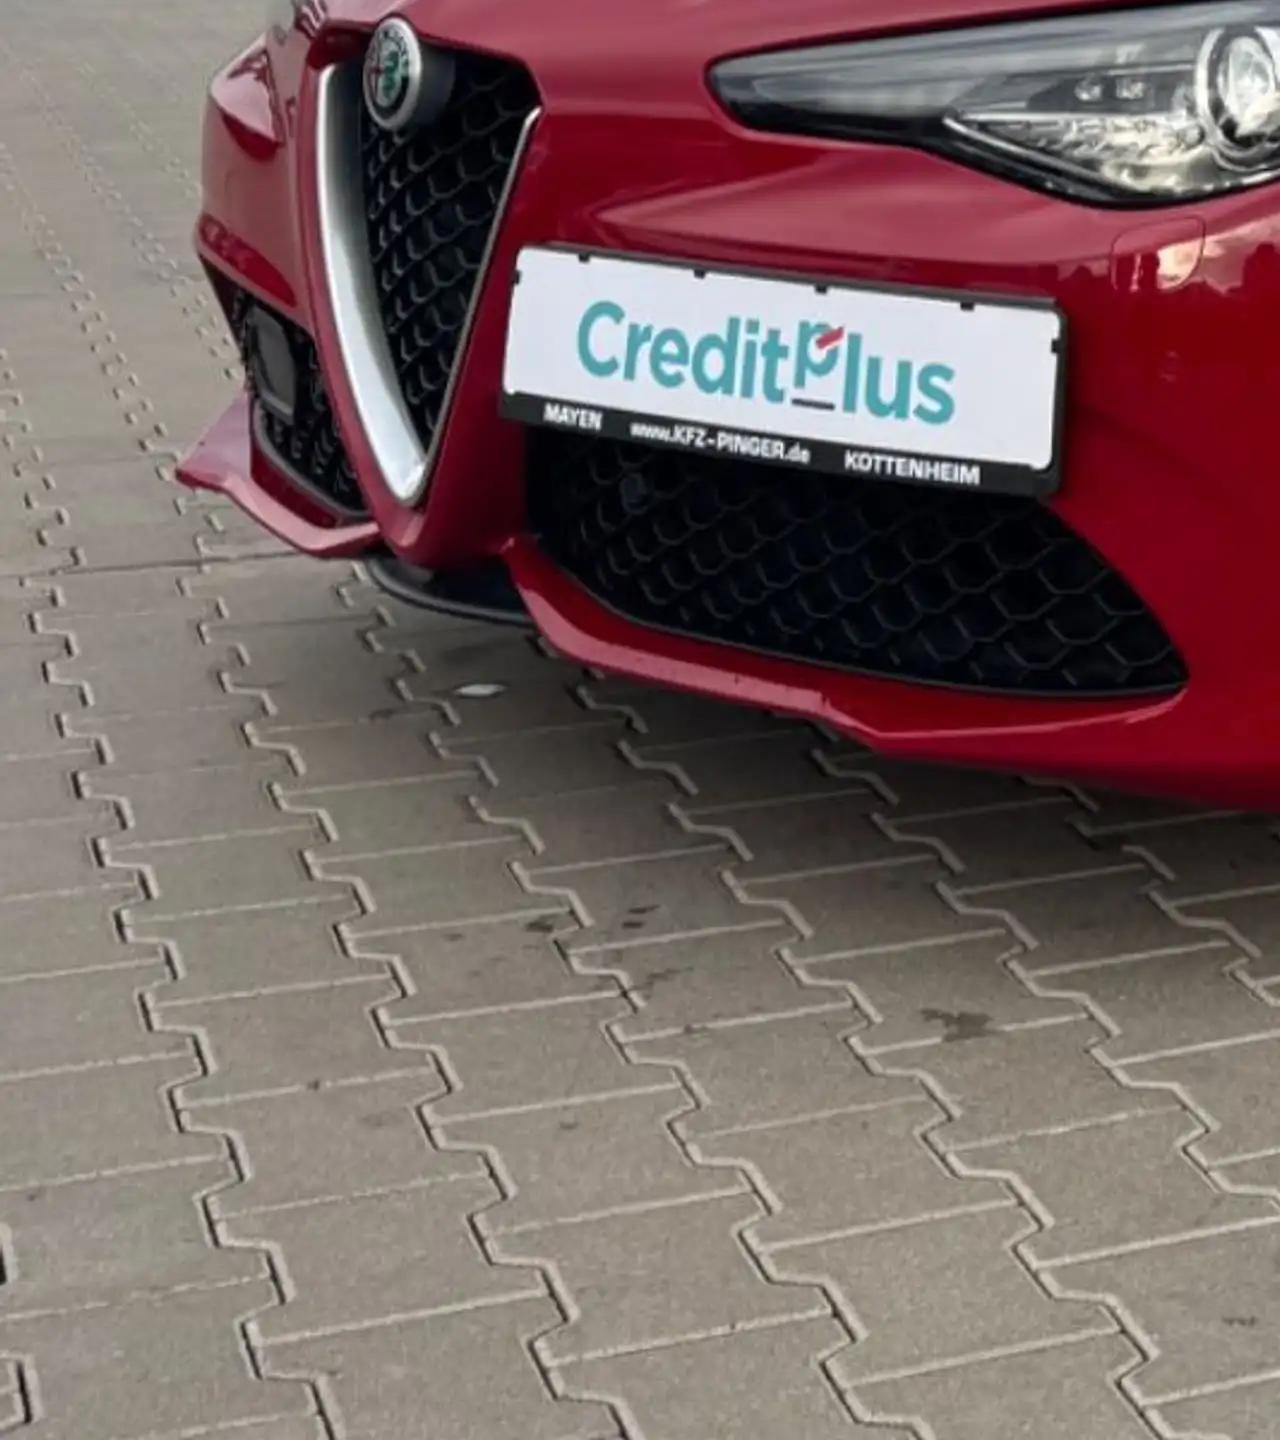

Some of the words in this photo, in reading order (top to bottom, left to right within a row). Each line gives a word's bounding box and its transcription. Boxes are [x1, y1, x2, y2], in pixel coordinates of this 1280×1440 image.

[577, 301, 955, 425] CreditPlus
[544, 402, 602, 430] MAYEN
[630, 421, 811, 463] www.KFZ-PINGER.de
[844, 450, 980, 485] KOTTENHEIM
